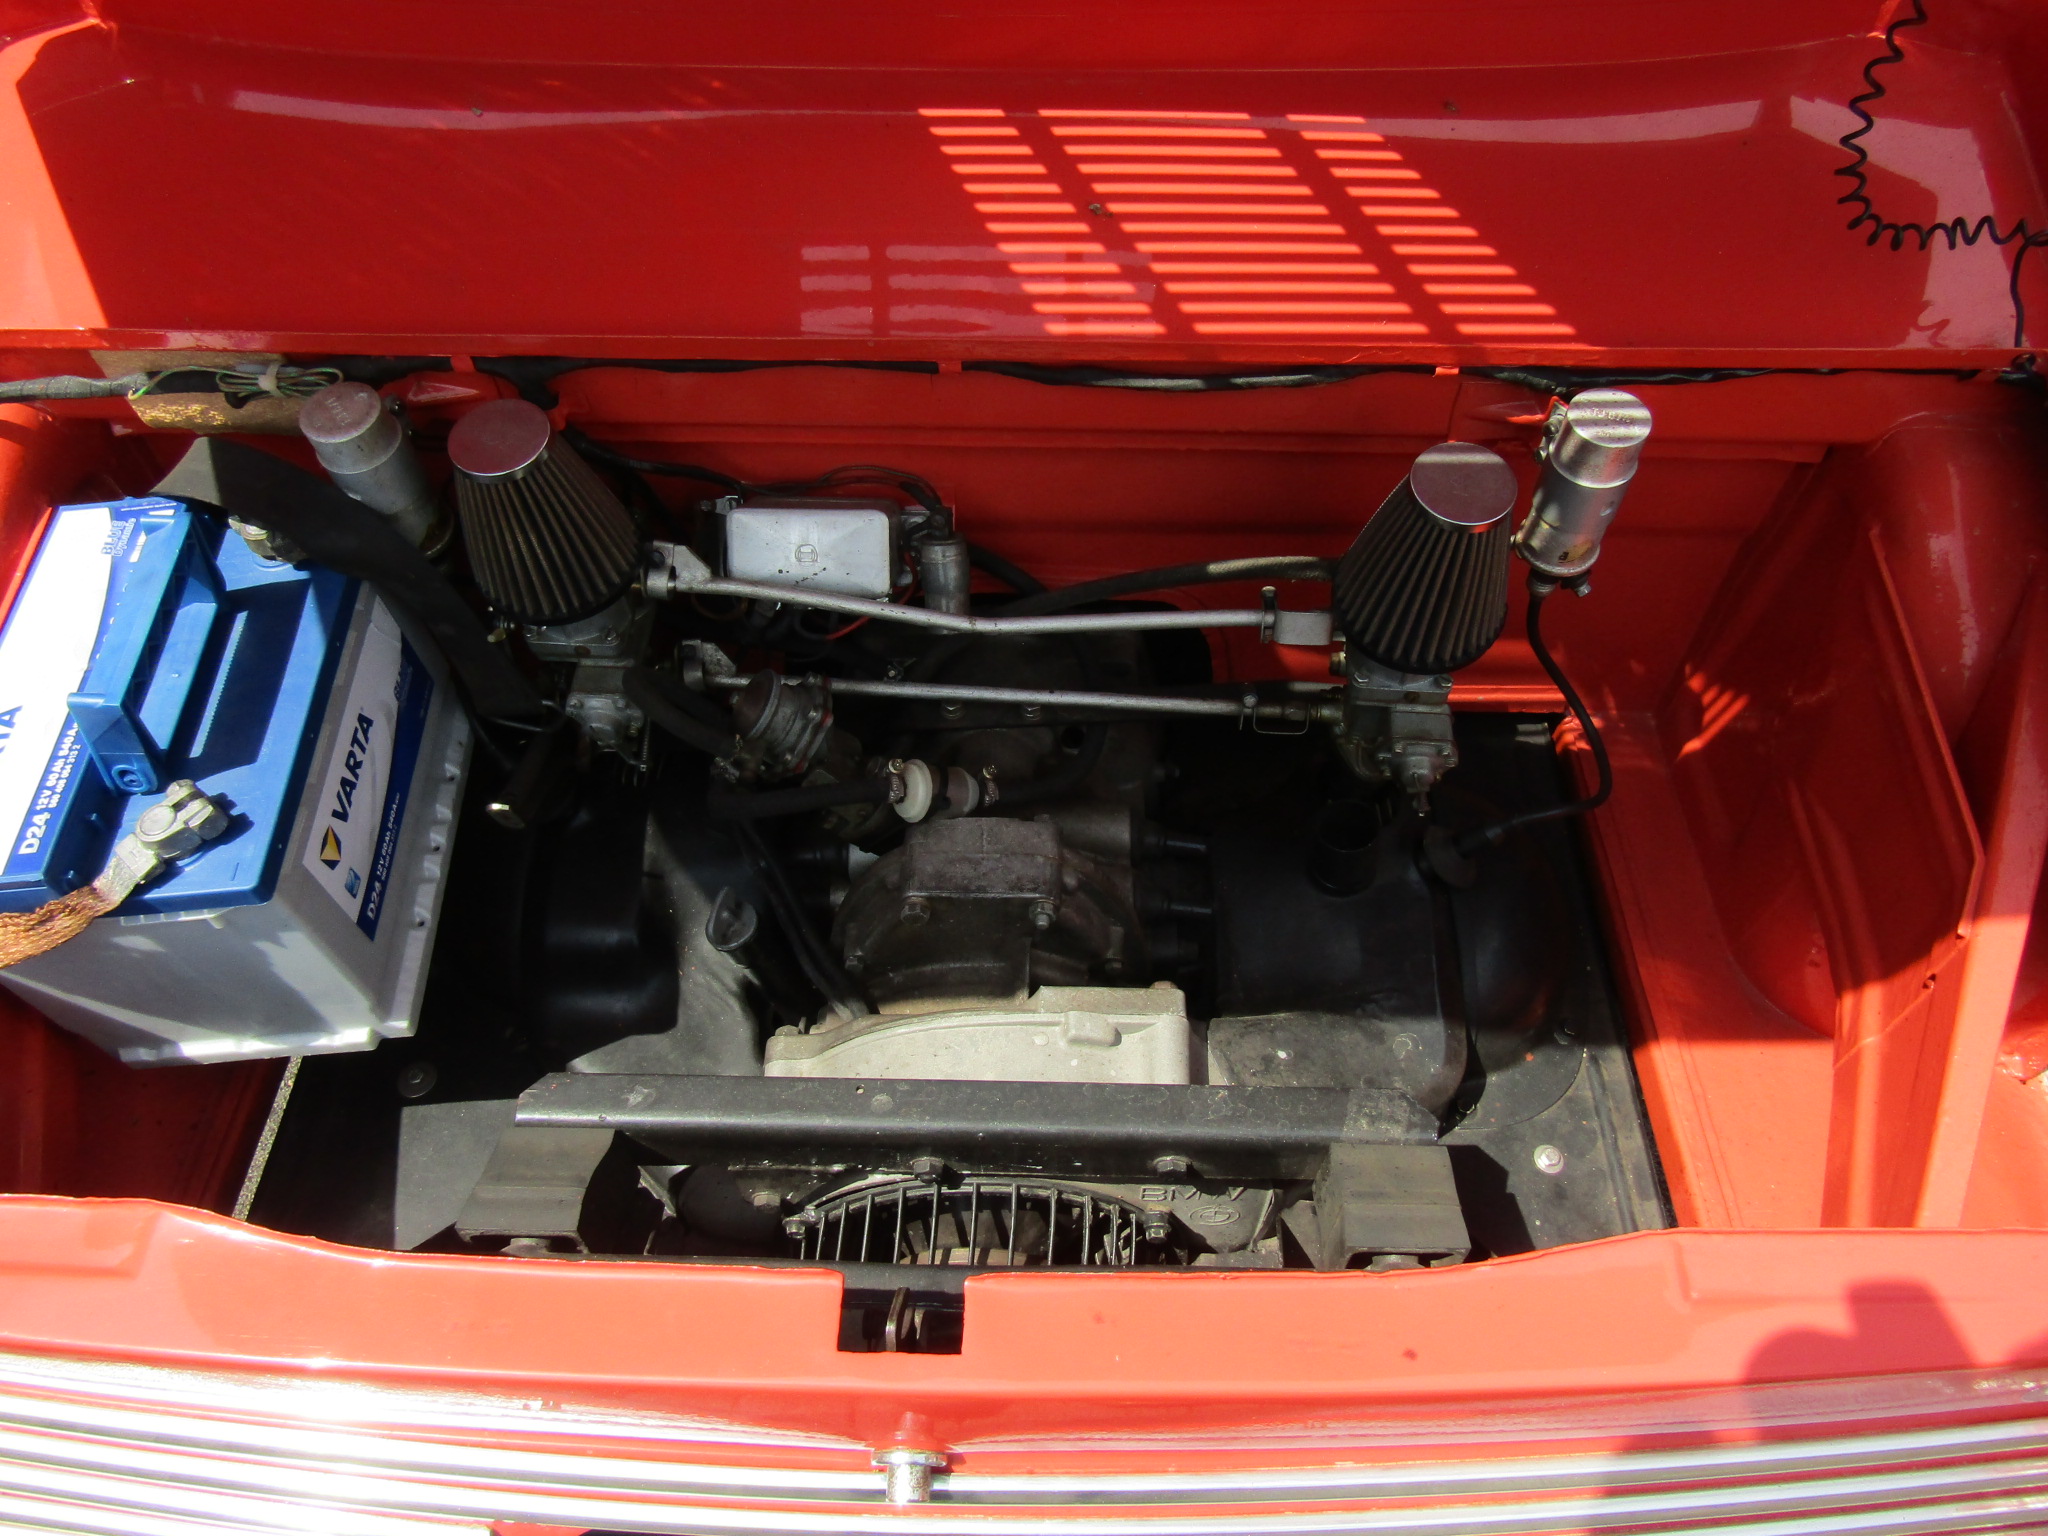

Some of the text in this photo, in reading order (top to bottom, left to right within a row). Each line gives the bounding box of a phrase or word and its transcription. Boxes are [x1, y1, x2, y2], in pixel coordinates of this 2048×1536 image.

[101, 520, 126, 555] BLUE
[113, 518, 136, 556] Dynamic
[66, 750, 79, 764] 313
[331, 713, 374, 823] VARTA
[18, 811, 51, 855] D24
[36, 789, 52, 811] 12V
[45, 758, 66, 787] 60Ah
[366, 880, 383, 920] D24
[376, 857, 384, 876] 12V
[381, 831, 391, 856] 60Ah
[1140, 1185, 1247, 1201] BMW
